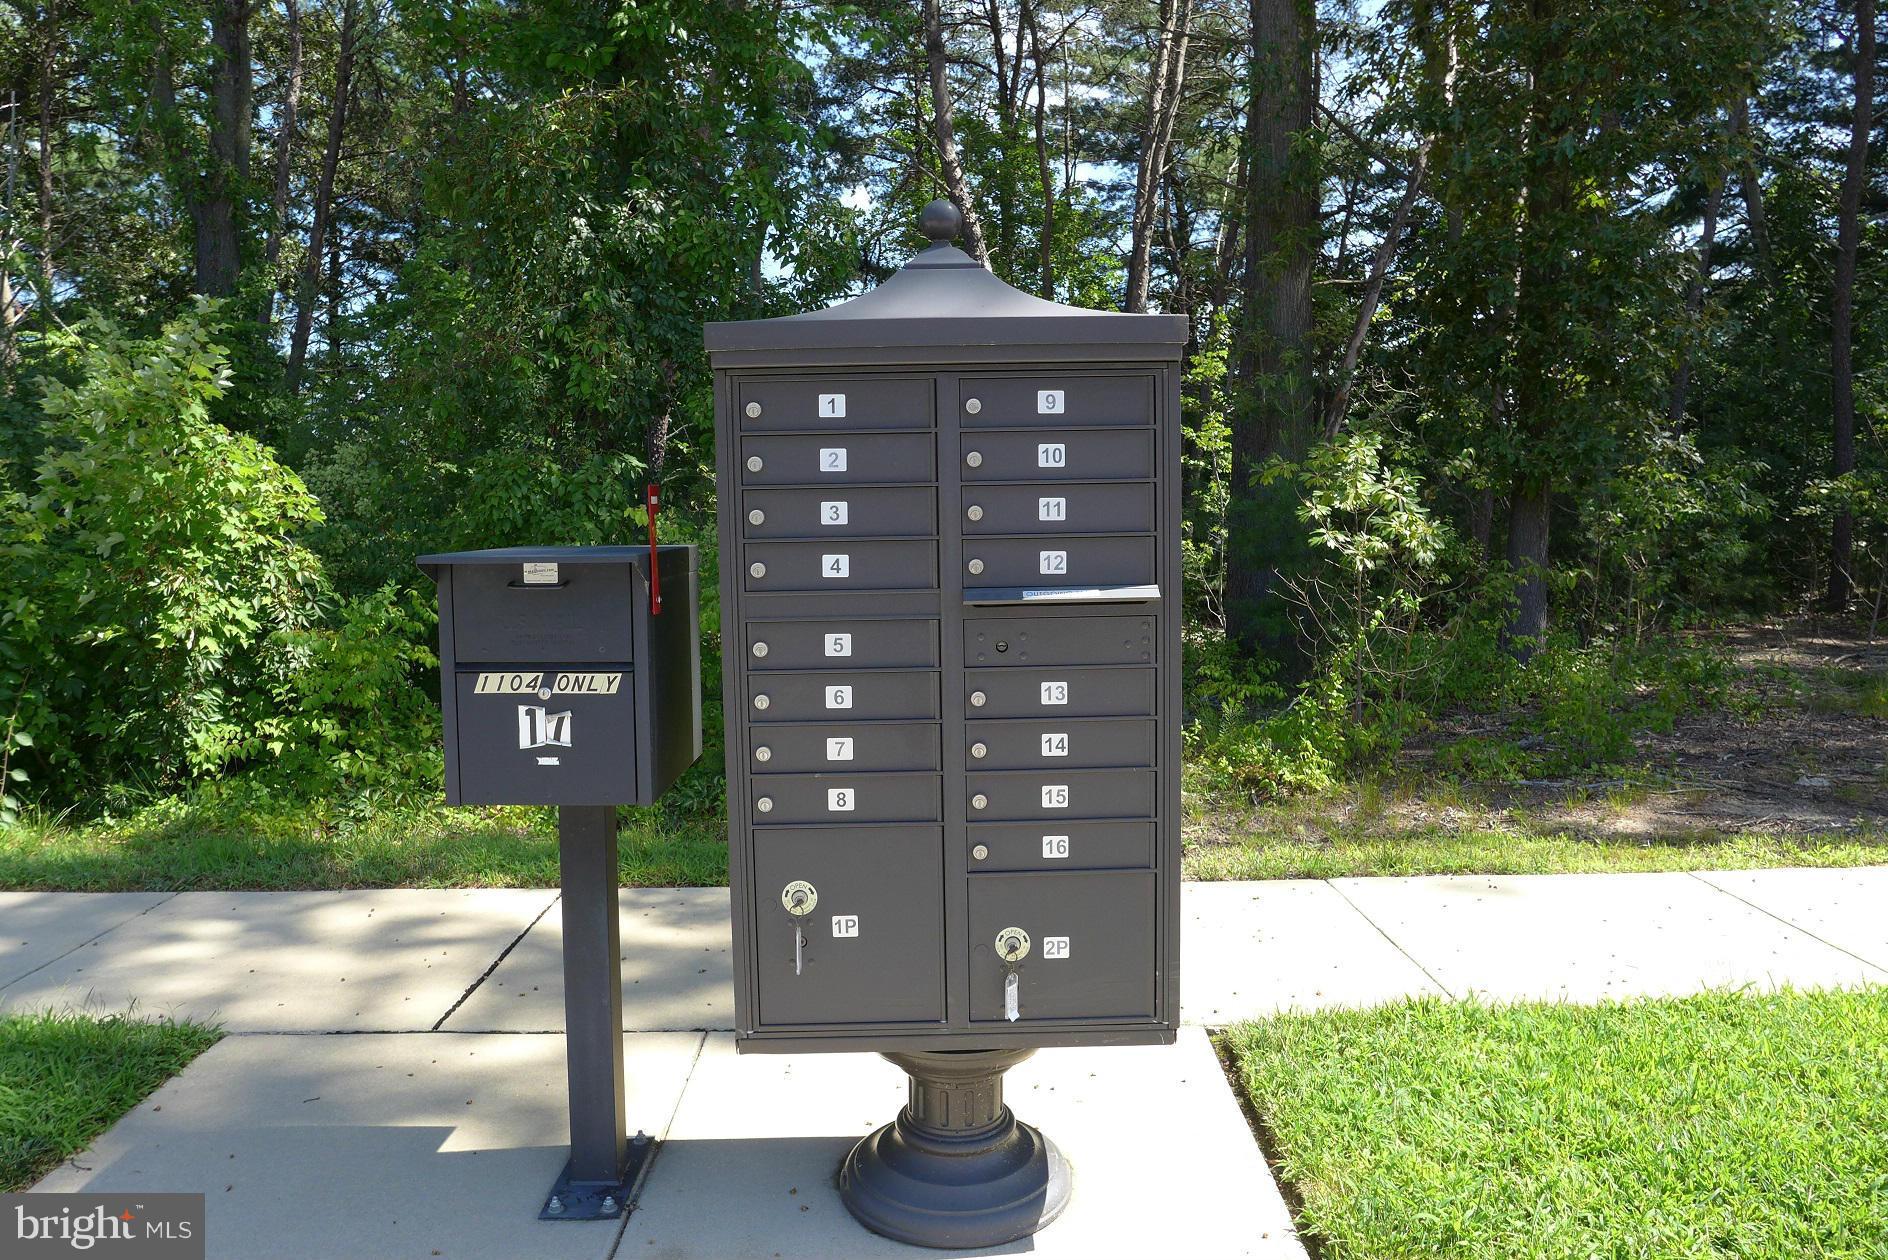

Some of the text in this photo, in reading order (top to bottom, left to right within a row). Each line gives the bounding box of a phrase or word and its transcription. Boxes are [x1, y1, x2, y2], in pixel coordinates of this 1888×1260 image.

[827, 397, 836, 415] 1
[1045, 393, 1057, 411] 9
[827, 451, 839, 469] 2
[1041, 447, 1063, 464] 10
[829, 505, 840, 522] 3
[1042, 500, 1061, 518] 11
[829, 557, 842, 574] 4
[1043, 554, 1065, 571] 12
[833, 637, 844, 654] 5
[480, 674, 618, 692] 1104 ONLY
[833, 689, 845, 706] 6
[1043, 685, 1066, 702] 13
[834, 741, 846, 757] 7
[1043, 735, 1068, 753] 14
[836, 791, 847, 808] 8
[1044, 788, 1067, 805] 15
[1045, 839, 1067, 855] 16
[790, 882, 808, 891] OPEN
[833, 917, 858, 935] 1P
[1044, 939, 1069, 957] 2P
